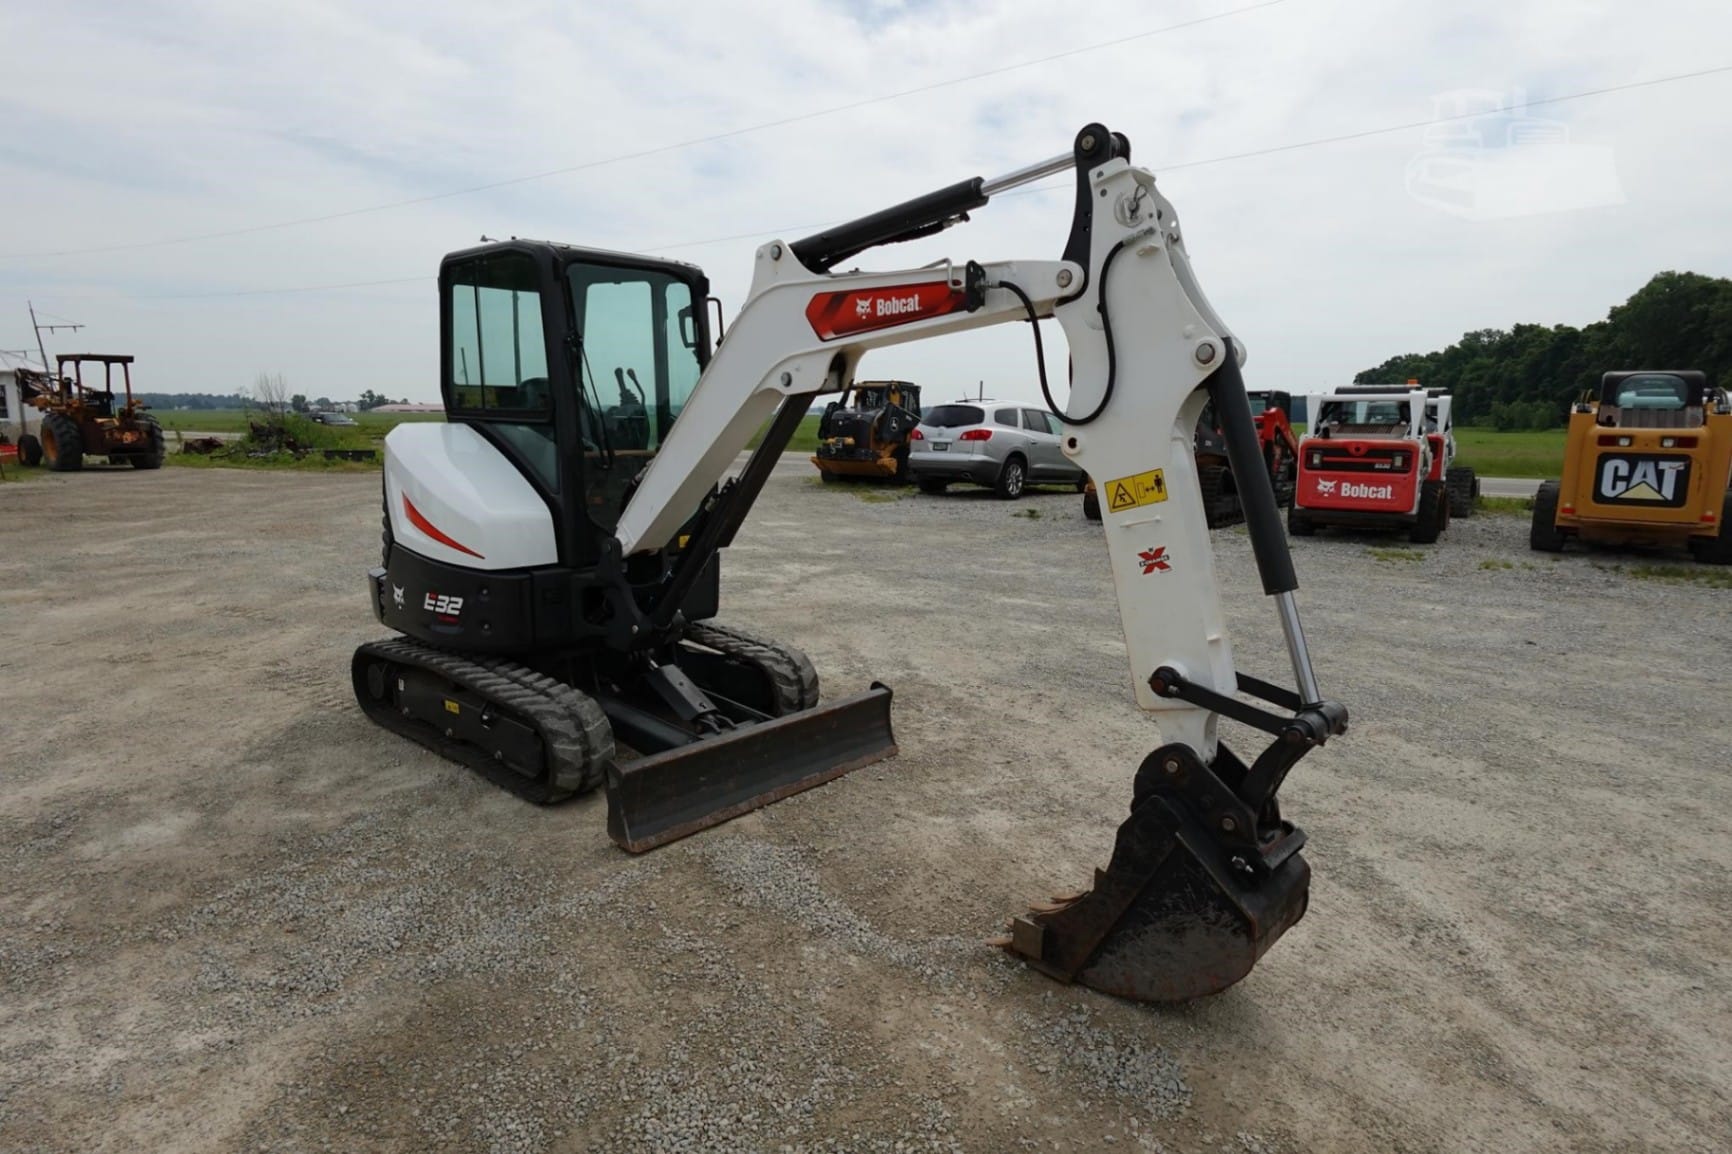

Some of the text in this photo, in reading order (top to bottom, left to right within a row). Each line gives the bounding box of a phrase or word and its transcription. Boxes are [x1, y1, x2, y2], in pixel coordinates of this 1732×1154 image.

[876, 294, 920, 316] Bobcat
[1340, 482, 1393, 499] Bobcat
[1601, 459, 1685, 500] CAT
[423, 592, 464, 615] E32
